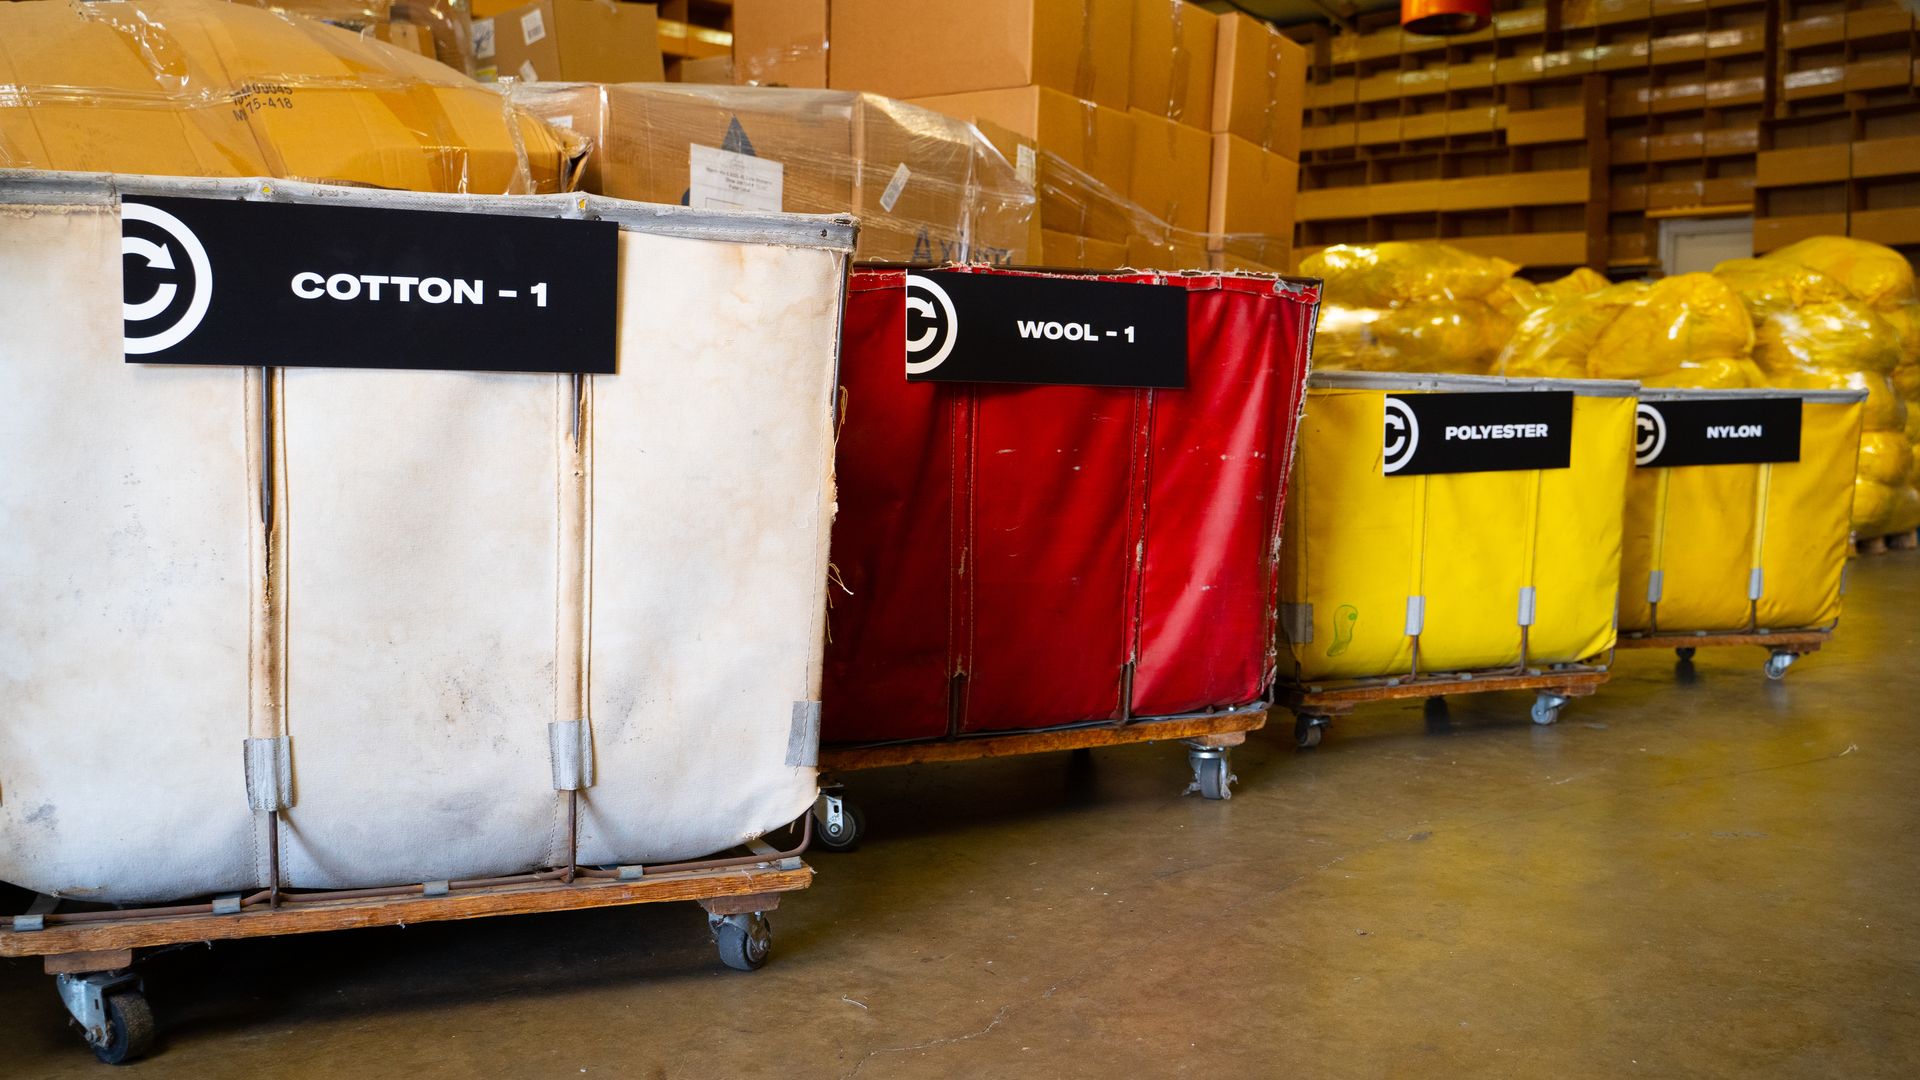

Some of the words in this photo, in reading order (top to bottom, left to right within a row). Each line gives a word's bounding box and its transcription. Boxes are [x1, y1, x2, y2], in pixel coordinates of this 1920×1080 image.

[291, 272, 484, 305] COTTON
[498, 289, 518, 298] -
[531, 283, 547, 308] 1
[1017, 320, 1098, 342] WOOL
[1124, 325, 1136, 344] 1
[1445, 424, 1549, 441] POLYESTER
[1706, 425, 1762, 439] NYLON
